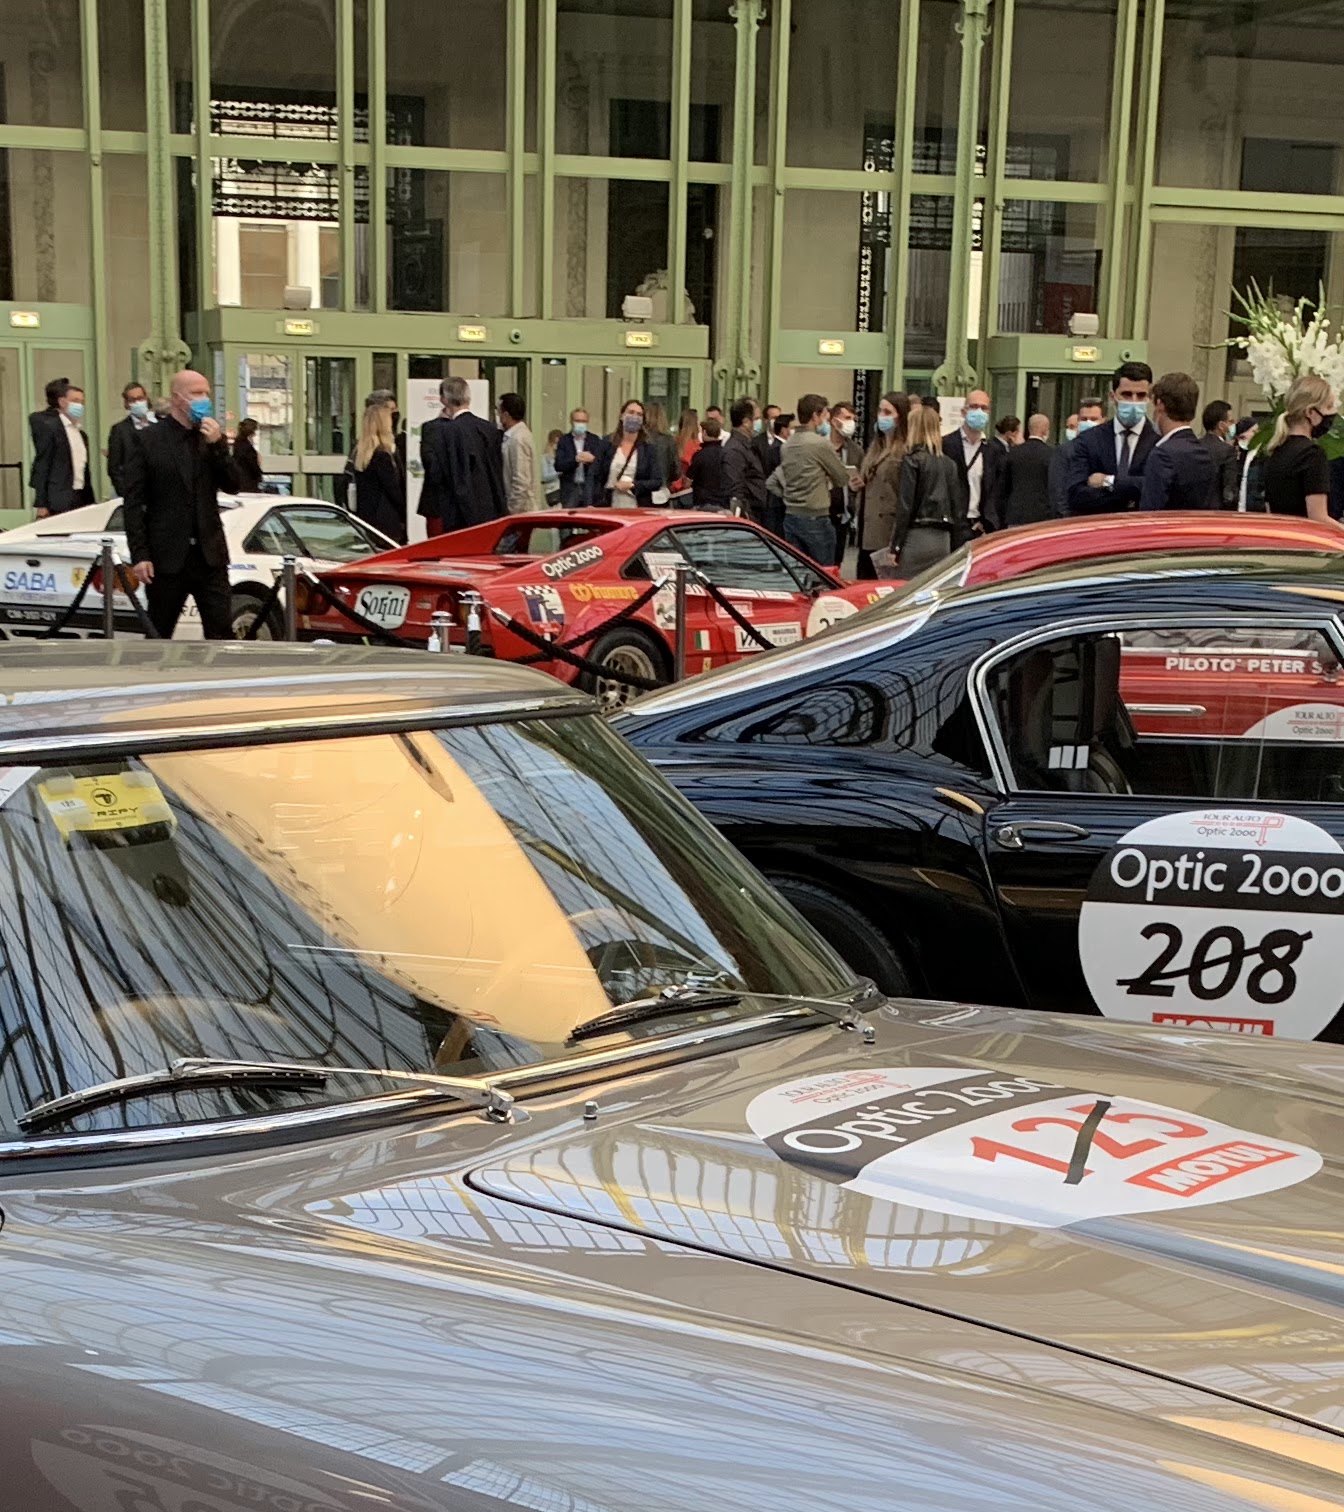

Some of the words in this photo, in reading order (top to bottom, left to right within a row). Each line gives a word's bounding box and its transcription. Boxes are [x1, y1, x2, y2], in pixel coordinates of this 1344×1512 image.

[541, 556, 574, 579] Optic
[573, 545, 604, 565] 2000
[4, 571, 57, 592] SABA
[1247, 658, 1305, 674] PETER
[1292, 725, 1314, 737] Optic
[1315, 726, 1335, 736] 2000
[1197, 826, 1227, 838] Optic
[1229, 826, 1258, 838] 2000
[1203, 813, 1232, 822] TOUR
[1232, 814, 1262, 823] AUTO
[1110, 847, 1228, 902] Optic
[1126, 921, 1306, 1005] 208
[782, 1101, 957, 1154] Optic
[914, 1076, 1066, 1107] 2000
[969, 1102, 1210, 1178] 125
[1146, 1143, 1286, 1194] MOTUL
